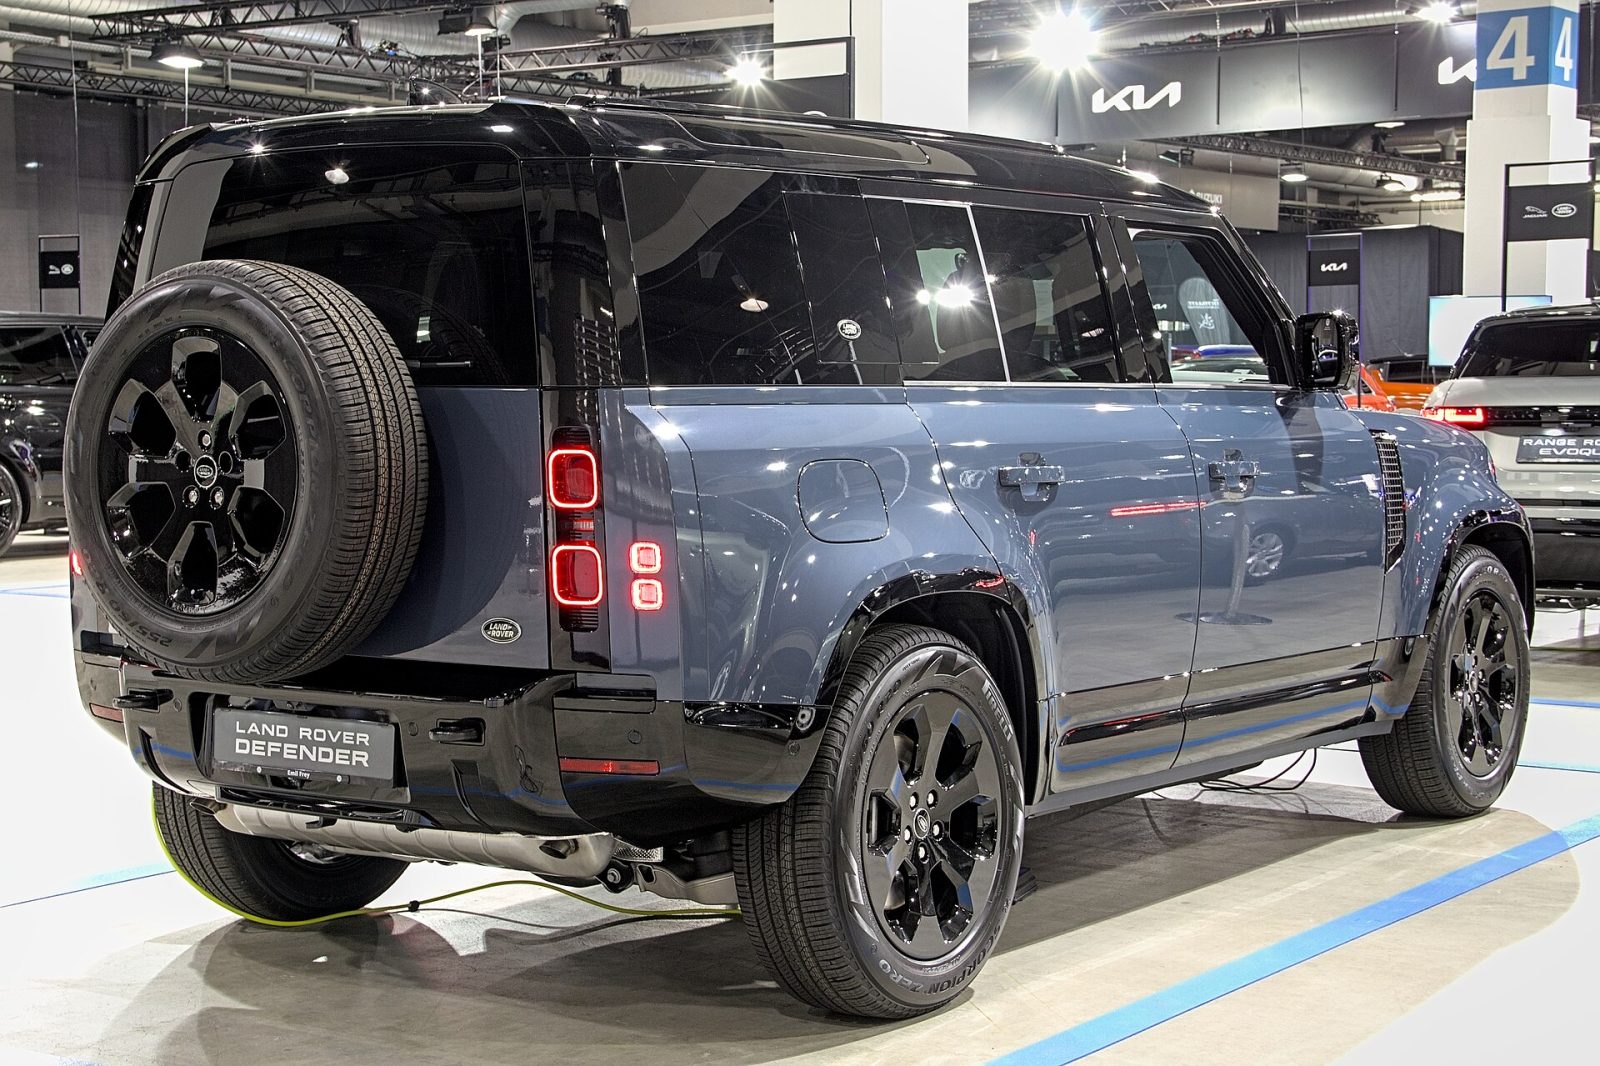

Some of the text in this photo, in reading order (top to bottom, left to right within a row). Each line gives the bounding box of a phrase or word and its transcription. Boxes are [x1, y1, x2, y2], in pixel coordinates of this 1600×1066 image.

[1486, 15, 1535, 81] 4
[1554, 16, 1573, 82] 4
[1091, 81, 1181, 113] KIA
[1320, 262, 1348, 272] KIA
[1523, 438, 1577, 446] RANGE
[489, 622, 509, 630] LAND
[491, 630, 514, 638] ROVER
[982, 678, 1013, 742] PIRELLI
[235, 720, 370, 746] LAND ROVER
[235, 738, 369, 768] DEFENDER
[287, 769, 310, 779] Emil Frey
[878, 924, 1001, 995] SCORPION ZERO
